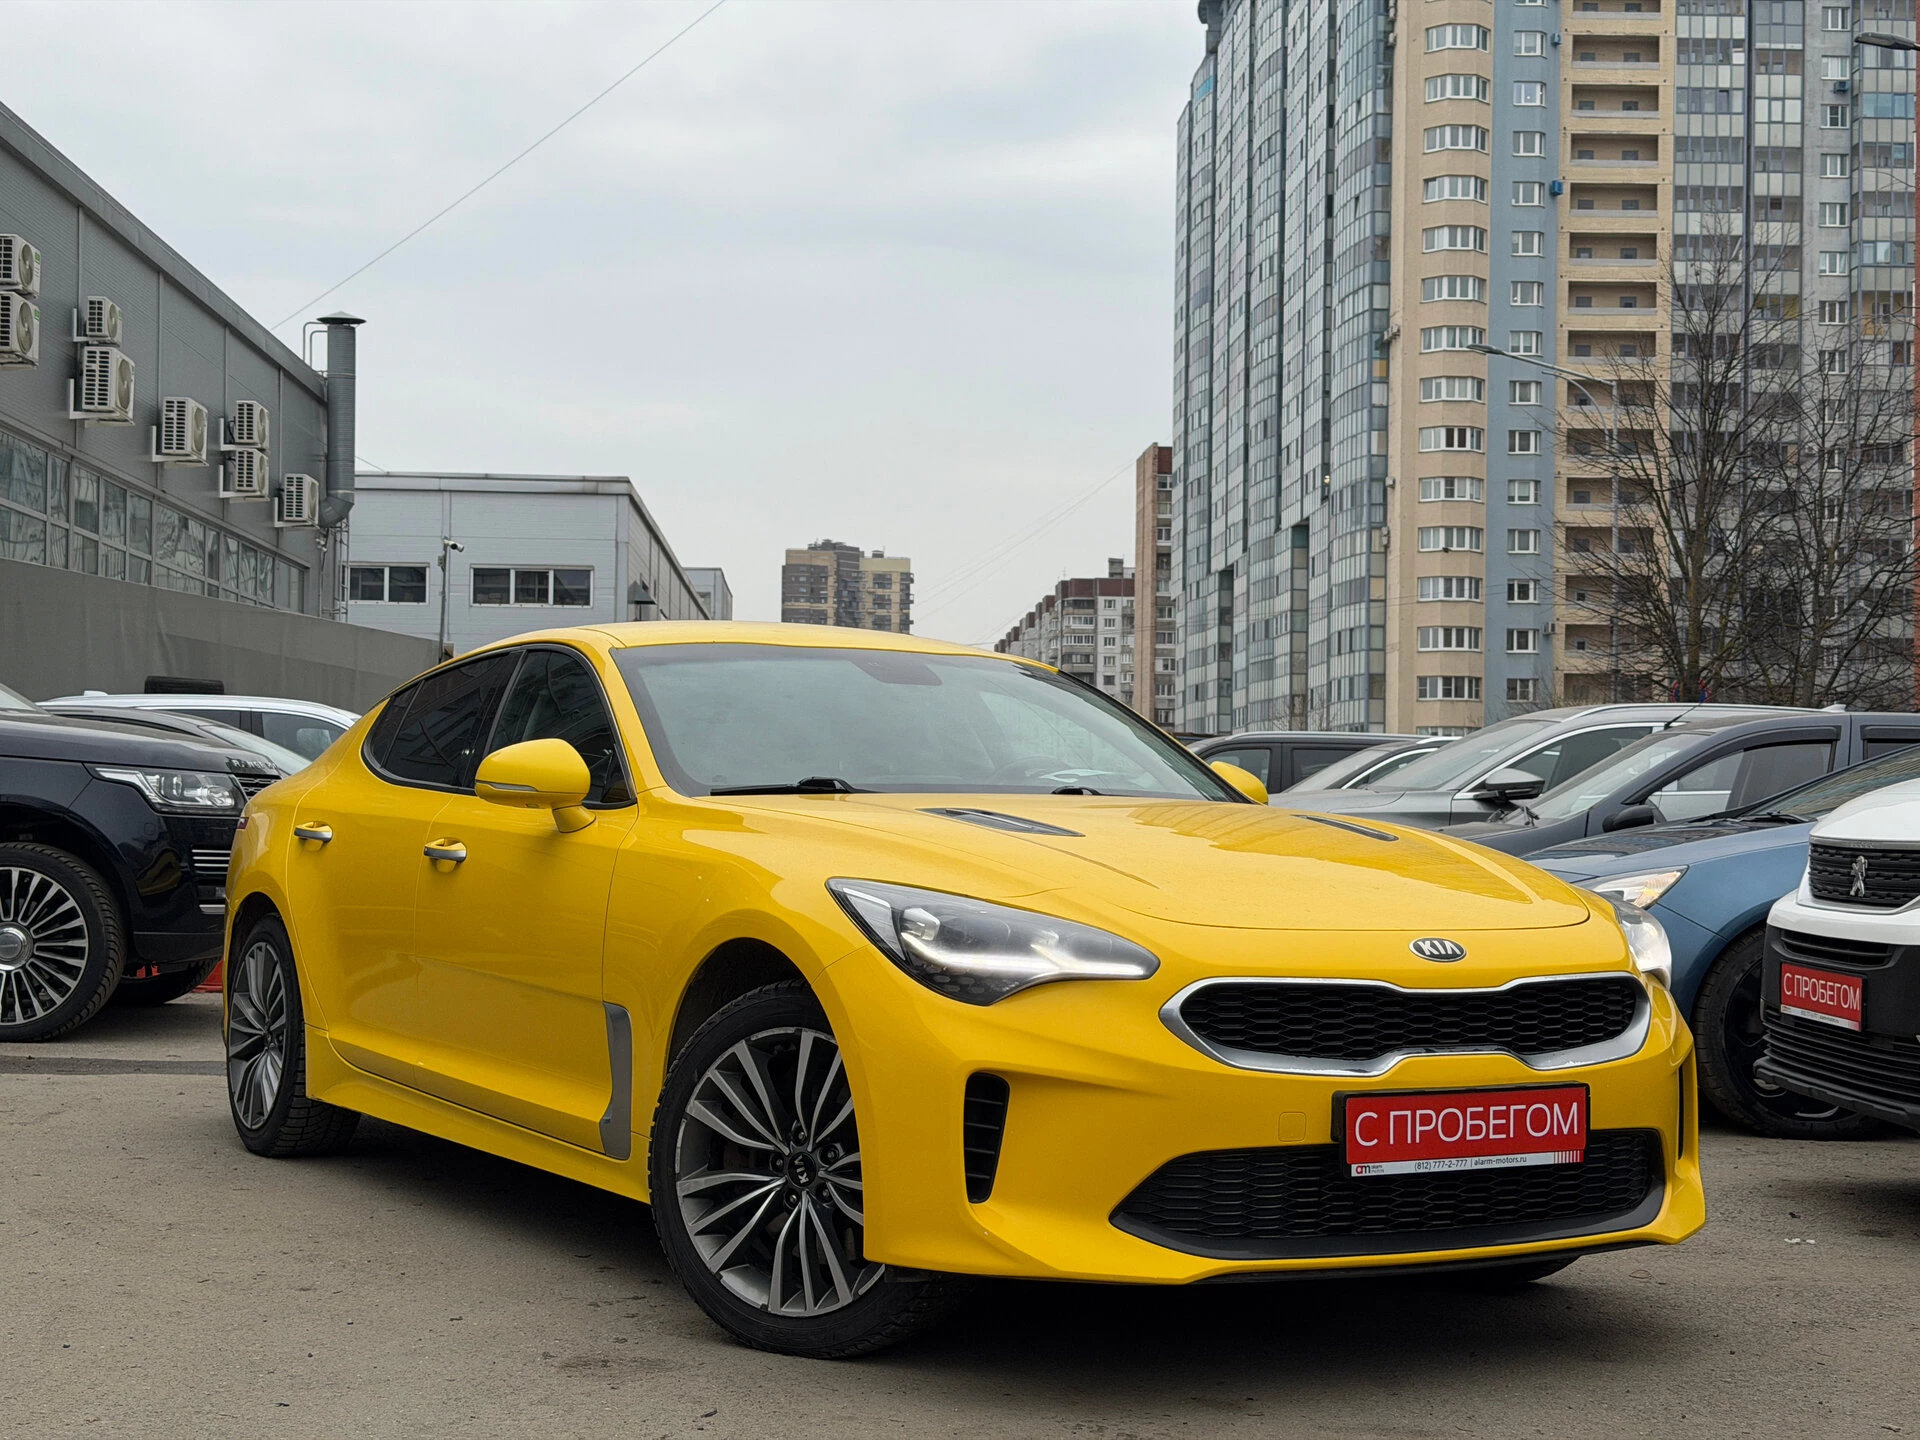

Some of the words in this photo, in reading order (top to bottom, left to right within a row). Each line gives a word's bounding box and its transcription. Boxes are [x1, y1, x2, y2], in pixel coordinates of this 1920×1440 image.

[1416, 940, 1462, 955] KIA
[1783, 972, 1792, 995] С
[1794, 975, 1860, 1011] ПРОБЕГОМ
[1355, 1112, 1378, 1147] С
[1389, 1102, 1578, 1145] ПРОБЕГОМ
[794, 1155, 809, 1184] KIA
[1414, 1161, 1431, 1172] (812)
[1433, 1159, 1467, 1170] 777-2-777
[1474, 1156, 1527, 1167] alarm-motors.ru
